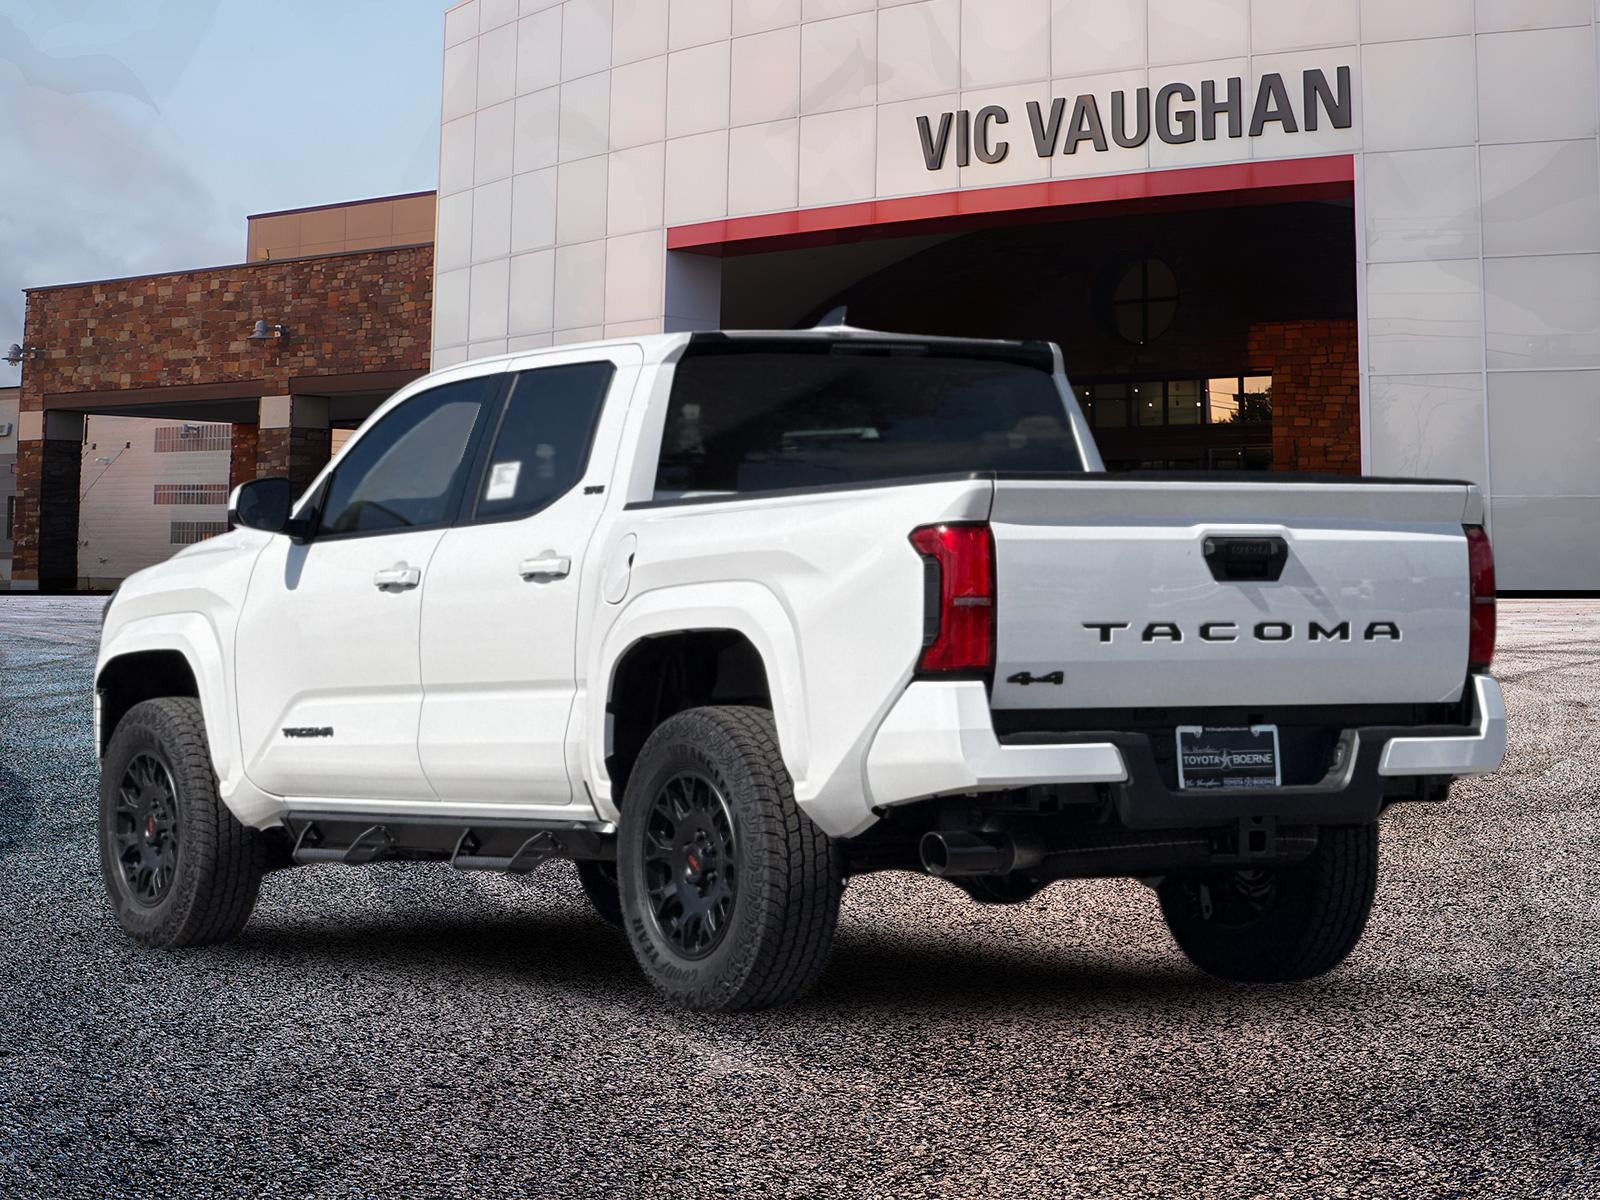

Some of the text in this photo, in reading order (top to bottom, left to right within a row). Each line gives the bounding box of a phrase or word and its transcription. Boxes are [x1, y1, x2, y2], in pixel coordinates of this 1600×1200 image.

[916, 65, 1353, 171] VIC VAUGHAN
[1082, 621, 1402, 644] TACOMA
[282, 726, 334, 738] TACOMA
[1183, 753, 1273, 765] TOYOTA BOERNE
